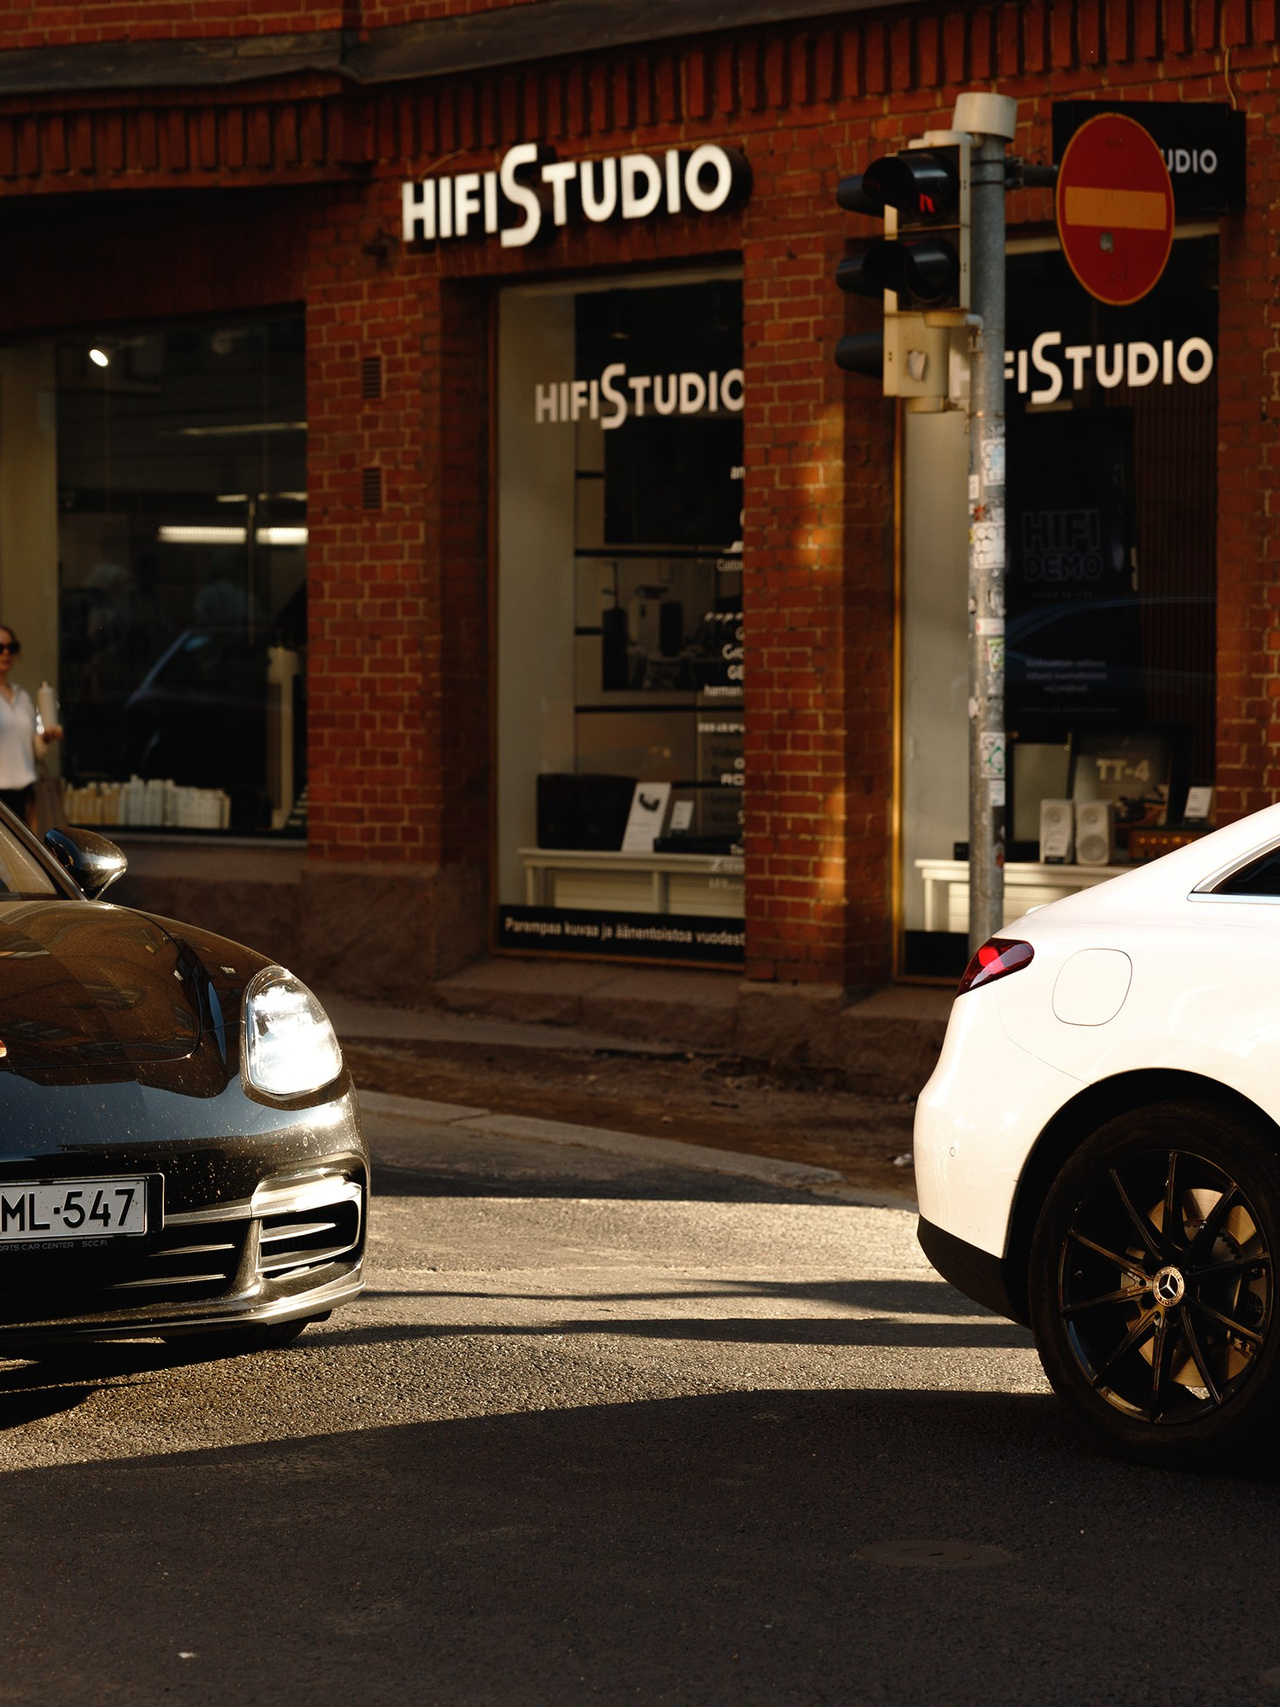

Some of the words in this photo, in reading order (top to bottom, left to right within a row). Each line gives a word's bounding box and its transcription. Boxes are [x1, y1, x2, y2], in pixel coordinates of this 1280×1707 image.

[401, 142, 733, 249] HIFISTUDIO
[1021, 509, 1101, 552] HIFI
[1023, 550, 1105, 582] DEMO
[1096, 758, 1151, 782] TT-4
[504, 916, 562, 938] Parempaa
[563, 920, 600, 939] kuvaa
[601, 922, 614, 942] ja
[694, 929, 745, 948] vuodest
[21, 1242, 41, 1251] CAR
[41, 1241, 75, 1250] CENTER
